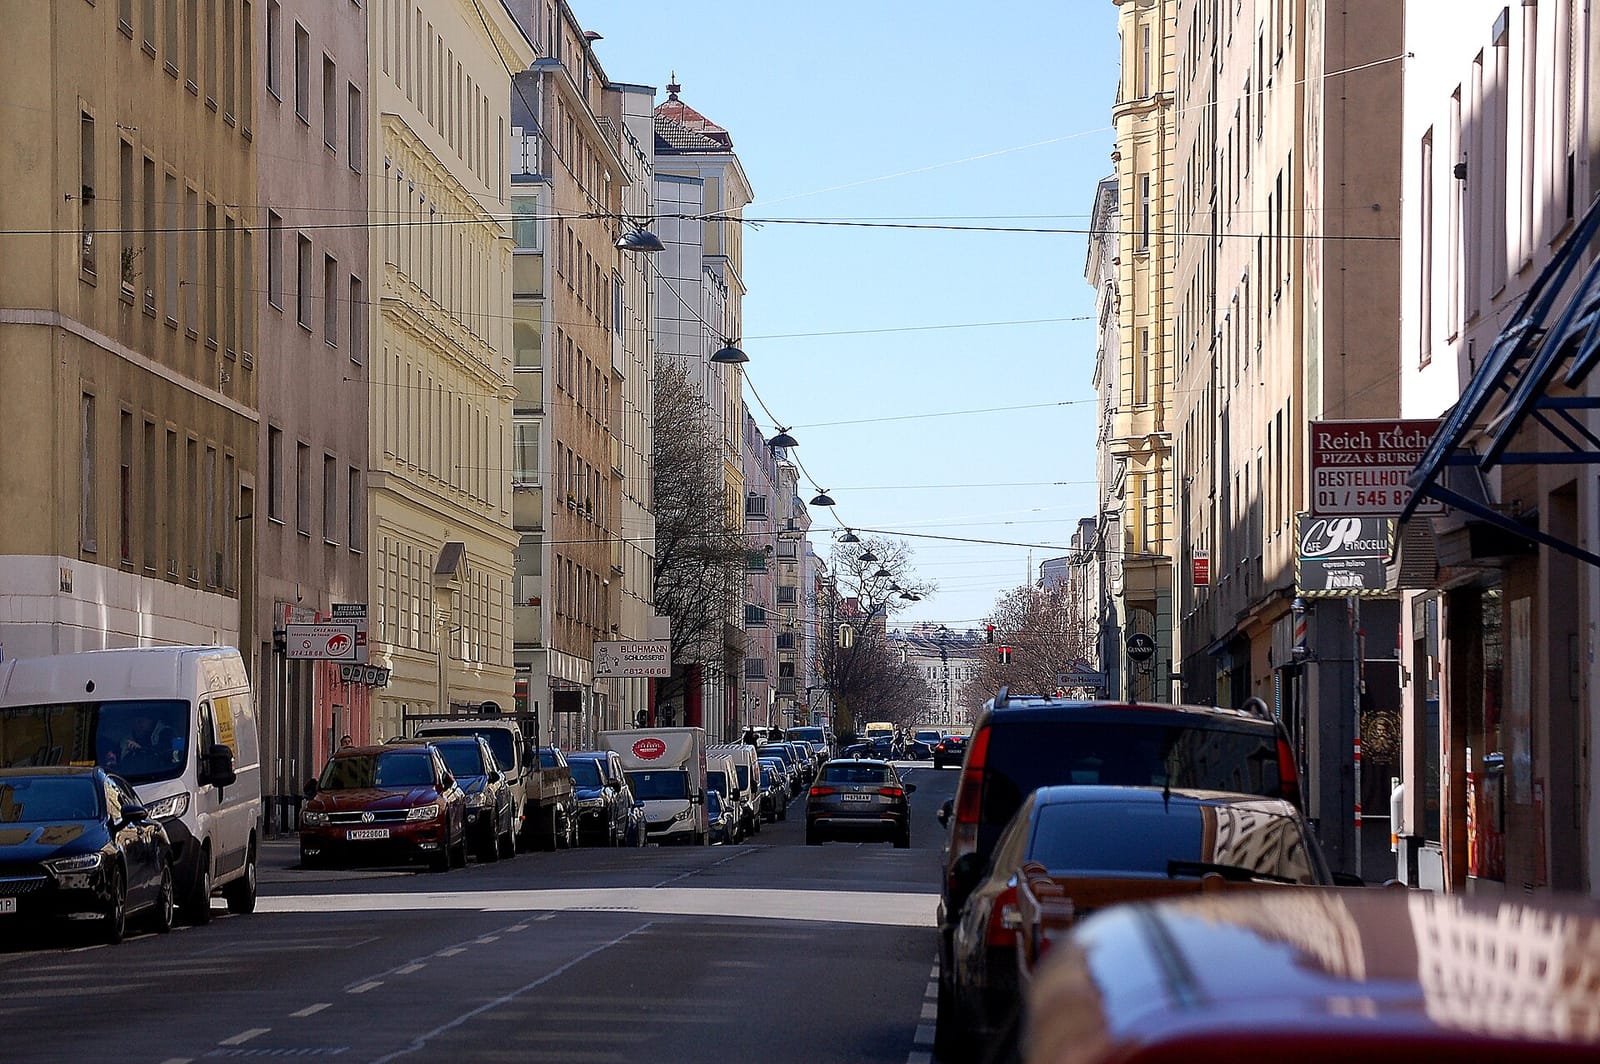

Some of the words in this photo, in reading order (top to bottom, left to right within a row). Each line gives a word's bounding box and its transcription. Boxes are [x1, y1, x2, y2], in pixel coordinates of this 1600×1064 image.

[1318, 432, 1371, 449] Reich
[1322, 453, 1361, 464] PIZZA
[1364, 453, 1374, 463] &
[1320, 491, 1337, 506] 01
[1356, 491, 1386, 506] 545
